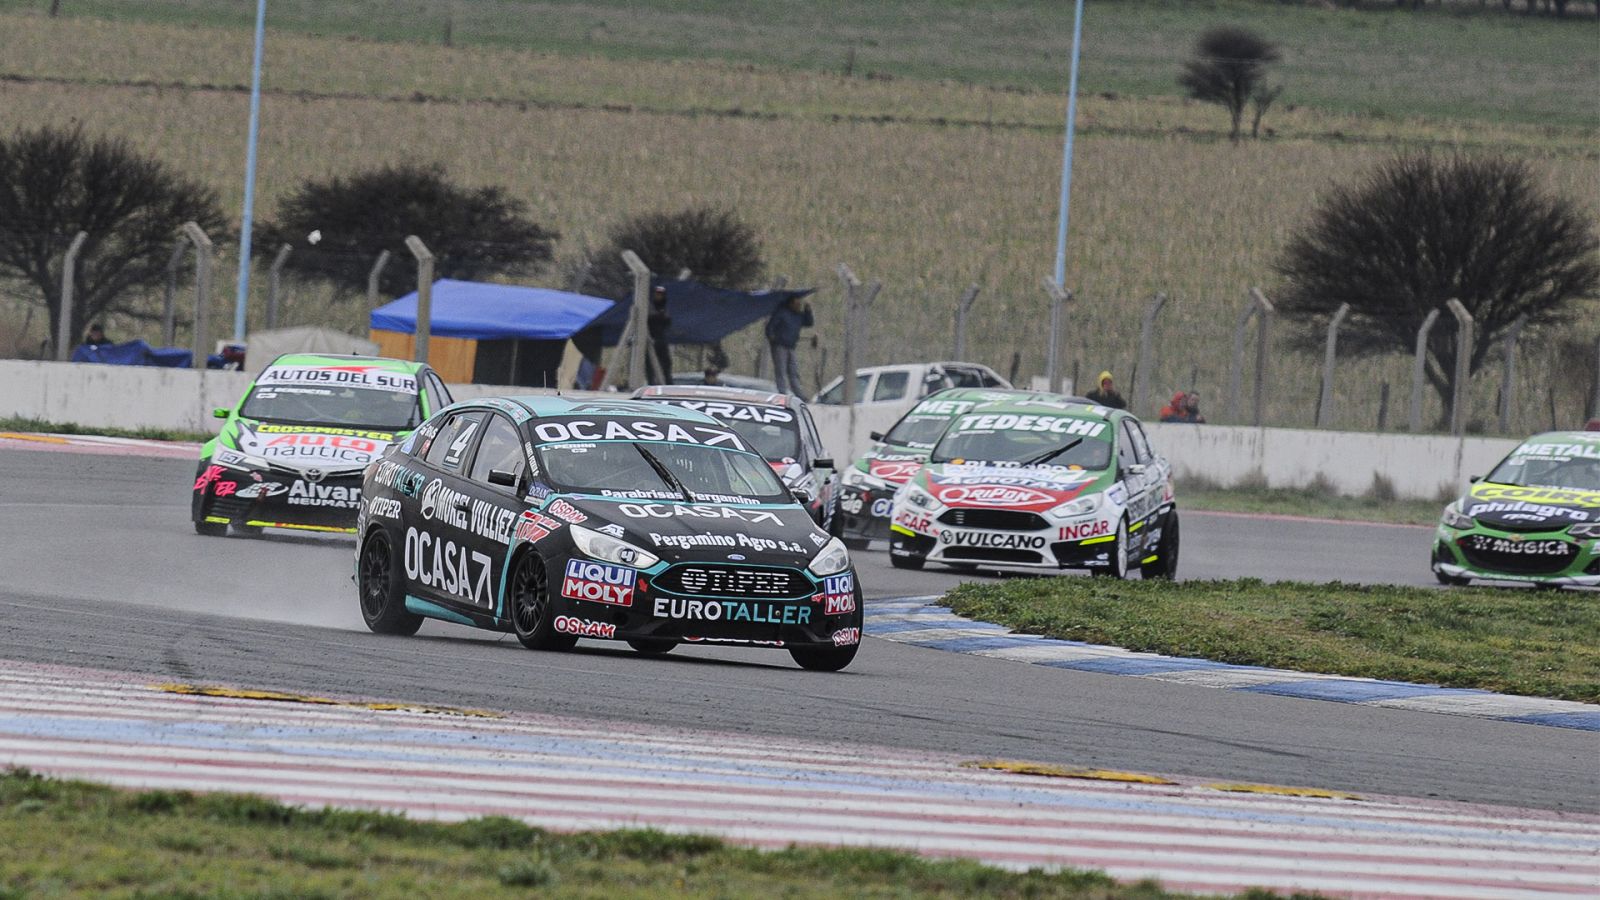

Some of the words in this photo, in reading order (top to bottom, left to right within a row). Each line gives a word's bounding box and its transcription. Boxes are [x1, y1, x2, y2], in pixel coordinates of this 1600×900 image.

[264, 369, 330, 381] AUTOS
[336, 371, 371, 384] DEL
[377, 375, 415, 391] SUR
[660, 400, 793, 424] YRAP
[257, 424, 394, 441] CROSSMASTER
[535, 421, 699, 444] OCASA
[959, 415, 1106, 437] TEDESCHI
[450, 422, 479, 458] 4
[263, 445, 372, 463] nautica
[601, 489, 684, 500] Parabrisas
[938, 476, 1066, 491] AGROTAX
[471, 499, 517, 545] VULLIEZ
[548, 498, 588, 524] OSRAM
[619, 503, 748, 521] OCASA
[1469, 501, 1590, 521] philagro
[955, 532, 1046, 549] VULCANO
[1059, 520, 1109, 541] INCAR
[649, 532, 735, 549] Pergamino
[736, 533, 777, 552] Agro
[404, 526, 474, 601] OCASA
[620, 551, 634, 562] 4
[568, 561, 633, 586] LIQUI
[565, 579, 632, 603] MOLY
[653, 597, 812, 625] EUROTALLER
[553, 615, 617, 638] OSRAM
